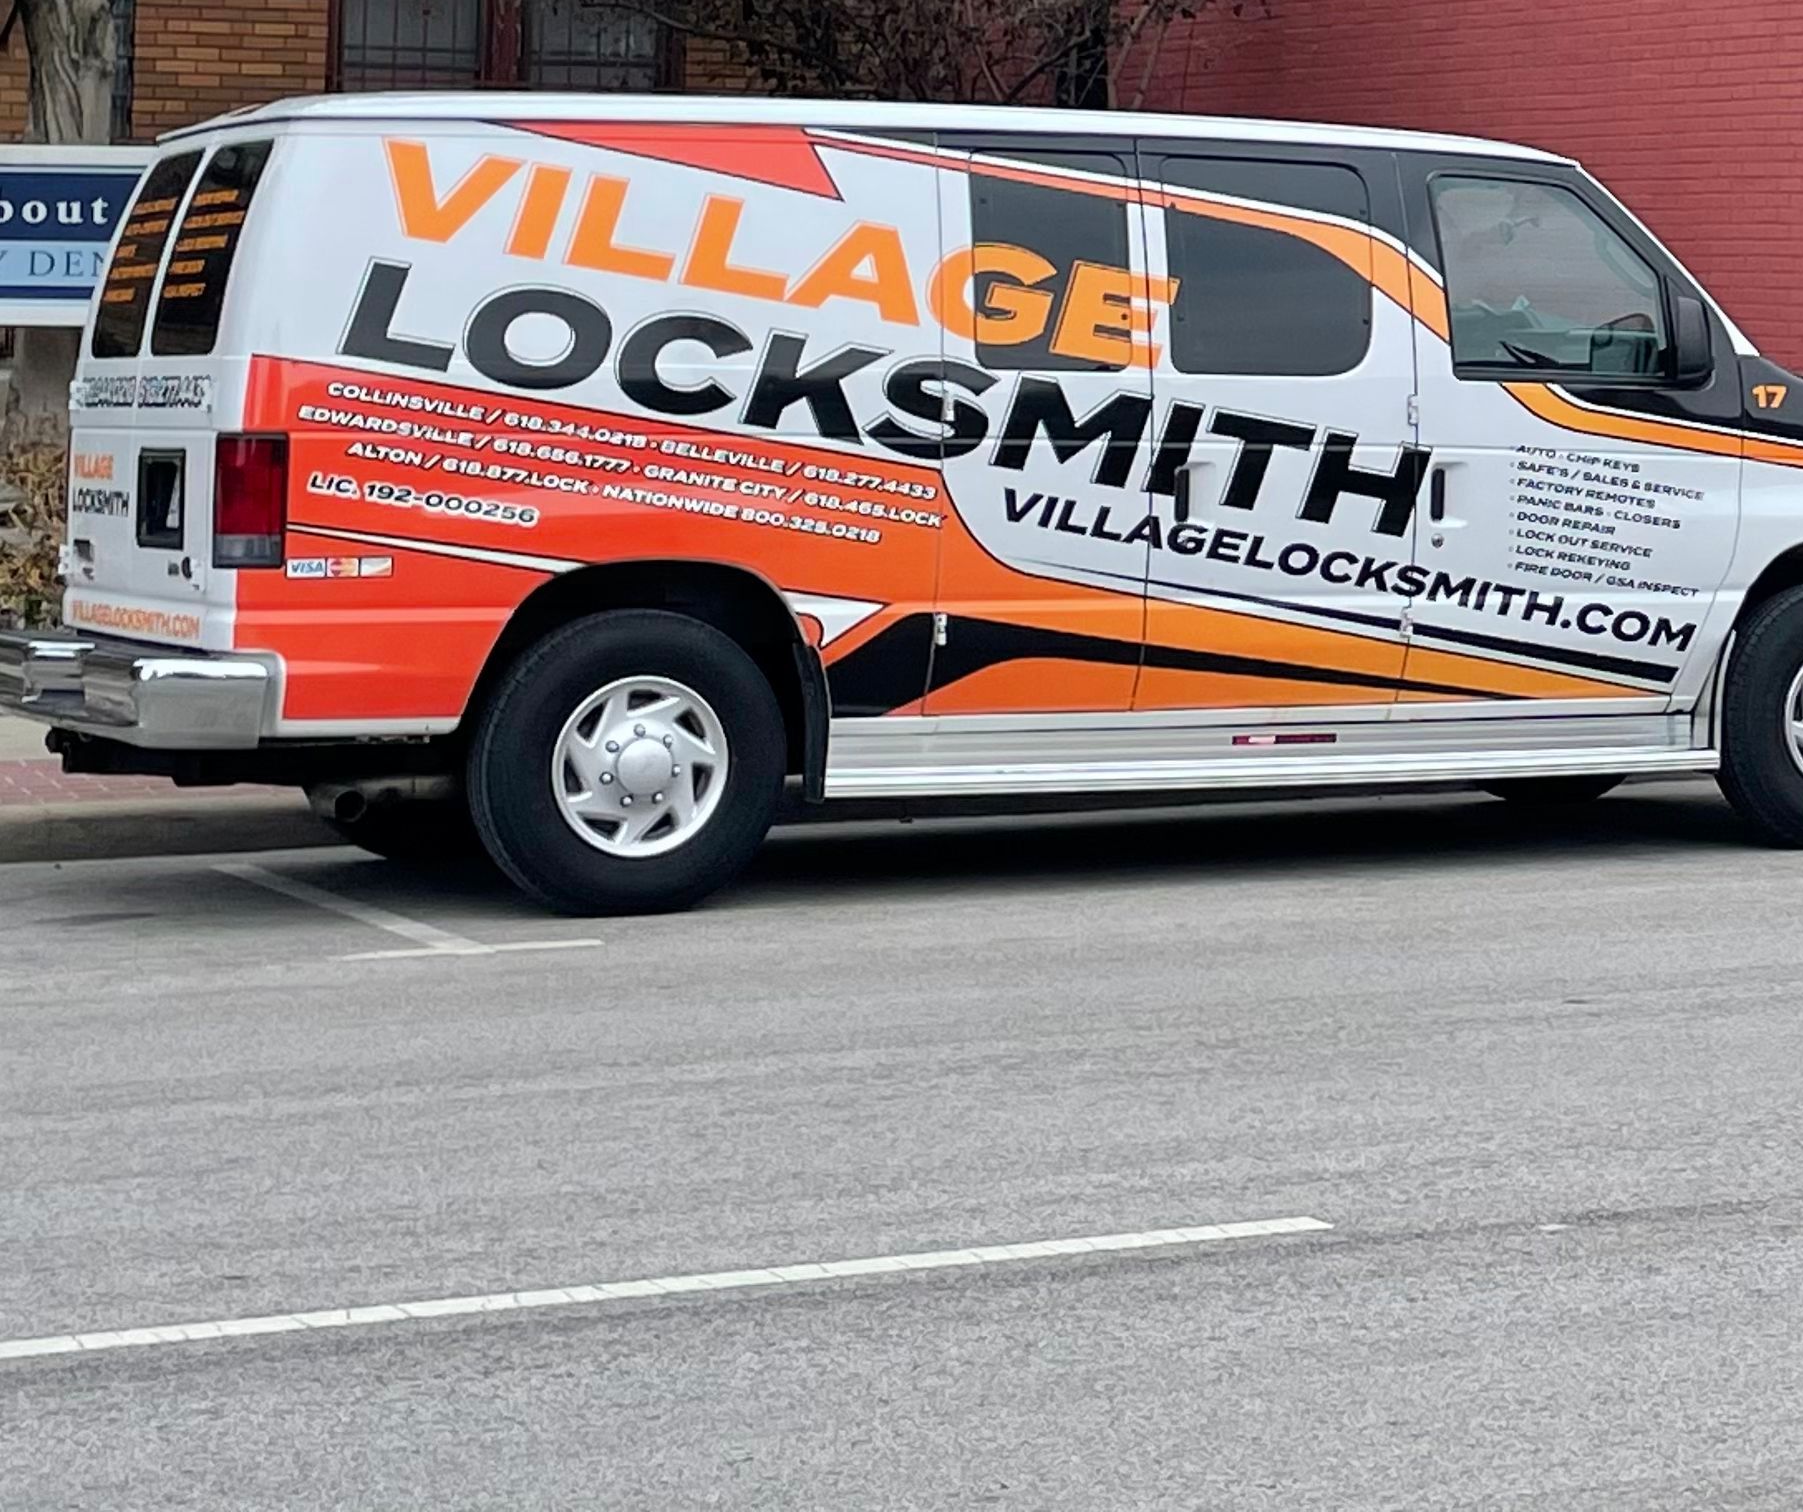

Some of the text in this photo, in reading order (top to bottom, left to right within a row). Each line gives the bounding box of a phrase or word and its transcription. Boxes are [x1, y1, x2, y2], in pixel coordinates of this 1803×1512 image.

[381, 136, 1181, 370] VILLAGE
[337, 257, 1434, 539] LOCKSMITH
[1751, 384, 1787, 409] 17
[298, 405, 475, 447] EDWARDSVILLE
[327, 382, 485, 421] COLLINSVILLE
[504, 412, 647, 449] 618.344.0218
[74, 454, 113, 480] VILLAGE
[347, 442, 423, 467] ALTON
[442, 458, 591, 495] 618.877.LOCK
[660, 440, 784, 474] BELLEVILLE
[803, 465, 936, 500] 618.277.4433
[1516, 445, 1641, 473] AUTO CHIP KEYS
[72, 488, 130, 518] LOCKSMITH
[309, 473, 539, 528] LIC. 192-000256
[603, 484, 738, 519] NATIONWIDE
[644, 464, 736, 493] GRANITE
[739, 480, 787, 500] CITY
[804, 491, 942, 528] 618.465.LOCK
[1517, 478, 1656, 509] FACTORY REMOTES
[1583, 472, 1629, 489] SALES
[1644, 482, 1705, 501] SERVICE
[1517, 494, 1681, 530] PANIC BARS CLOSERS
[1517, 511, 1616, 535] DOOR REPAIR
[1515, 545, 1631, 571] LOCK REKEYING
[1516, 528, 1653, 558] LOCK OUT SERVICE
[290, 561, 325, 574] VISA
[1004, 488, 1698, 653] VILLAGELOCKSMITH.COM
[1515, 561, 1549, 575] FIRE
[1550, 568, 1593, 582] DOOR
[1606, 577, 1635, 590] GSA
[1637, 581, 1700, 598] INSPECT
